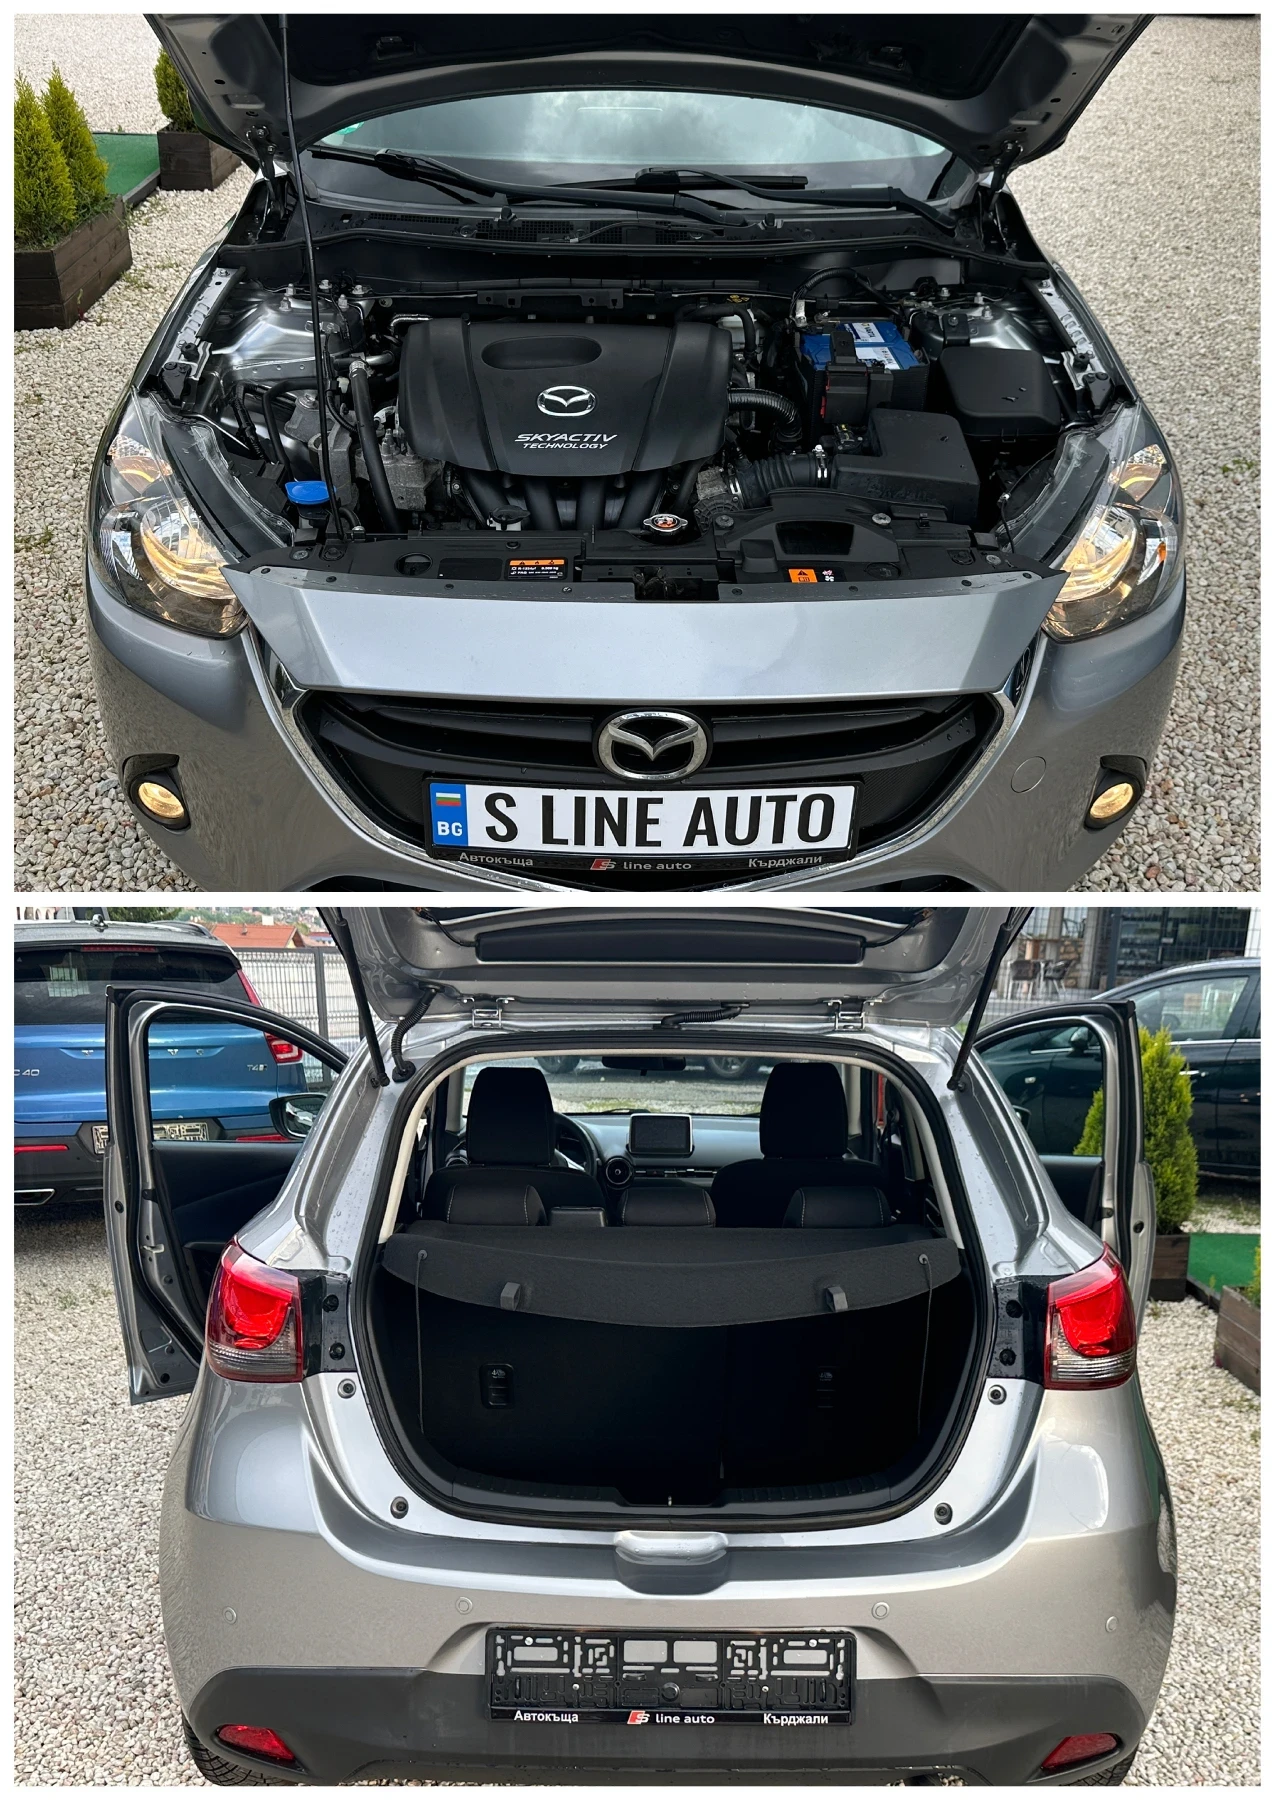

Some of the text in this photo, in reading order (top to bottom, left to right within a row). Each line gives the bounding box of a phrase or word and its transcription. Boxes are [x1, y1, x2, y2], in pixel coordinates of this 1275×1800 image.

[514, 433, 618, 442] SKYACTIV
[484, 792, 836, 847] S LINE AUTO
[437, 821, 463, 837] BG
[459, 852, 534, 867] Автокъща
[623, 861, 652, 870] line
[656, 862, 692, 870] auto
[748, 855, 823, 868] Кърджали
[513, 1710, 579, 1724] Автокъща
[655, 1713, 681, 1724] line
[684, 1714, 715, 1724] auto
[763, 1713, 829, 1727] Кърджали
